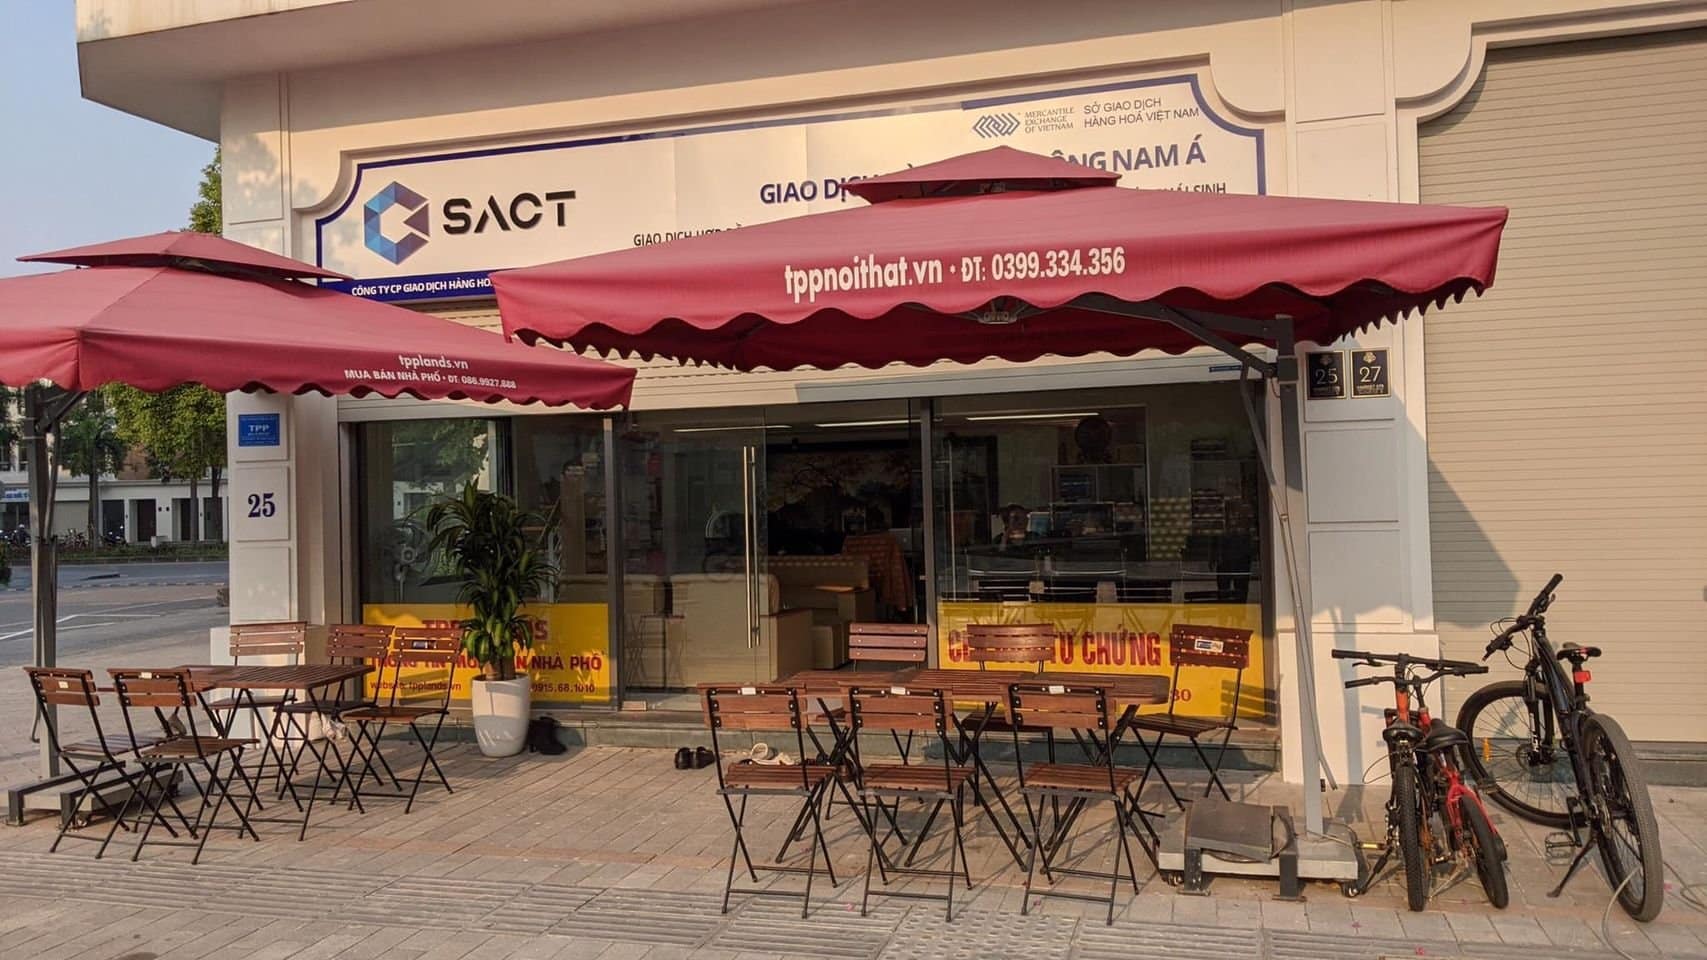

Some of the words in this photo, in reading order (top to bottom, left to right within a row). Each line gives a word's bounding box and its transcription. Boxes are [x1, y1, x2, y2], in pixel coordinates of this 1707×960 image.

[1025, 107, 1075, 118] MERCANTILE
[1104, 100, 1132, 113] GIAO
[1134, 98, 1163, 112] DỊCH
[1025, 115, 1068, 126] EXCHANGE
[1084, 114, 1117, 128] HÀNG
[1118, 110, 1144, 125] HOÁ
[1144, 110, 1172, 124] VIỆT
[1173, 107, 1200, 119] NAM
[1025, 125, 1036, 134] OF
[1037, 121, 1075, 132] VIETNAM
[760, 180, 818, 204] GIAO
[1112, 143, 1178, 172] NAM
[1186, 133, 1207, 165] Á
[442, 190, 577, 235] SACT
[633, 232, 662, 247] GIAO
[784, 254, 943, 303] tppnoithat.vn
[961, 256, 987, 283] ĐT:
[991, 246, 1126, 280] 0399.334.356
[351, 284, 377, 297] CÔNG
[377, 284, 390, 294] TY
[390, 283, 402, 294] CP
[403, 282, 425, 293] GIAO
[425, 281, 446, 293] DỊCH
[448, 276, 476, 290] HÀNG
[477, 277, 493, 288] HO
[398, 354, 469, 370] tpplands.vn
[344, 369, 372, 380] MUA
[373, 369, 396, 381] BÁN
[398, 369, 420, 381] NHÀ
[421, 370, 441, 382] PHỐ
[1315, 367, 1338, 386] 25
[1359, 366, 1382, 383] 27
[248, 424, 270, 433] TPP
[247, 491, 276, 519] 25
[1081, 623, 1161, 667] CHỨNG
[532, 652, 564, 670] NHÀ
[570, 650, 605, 670] PHỐ
